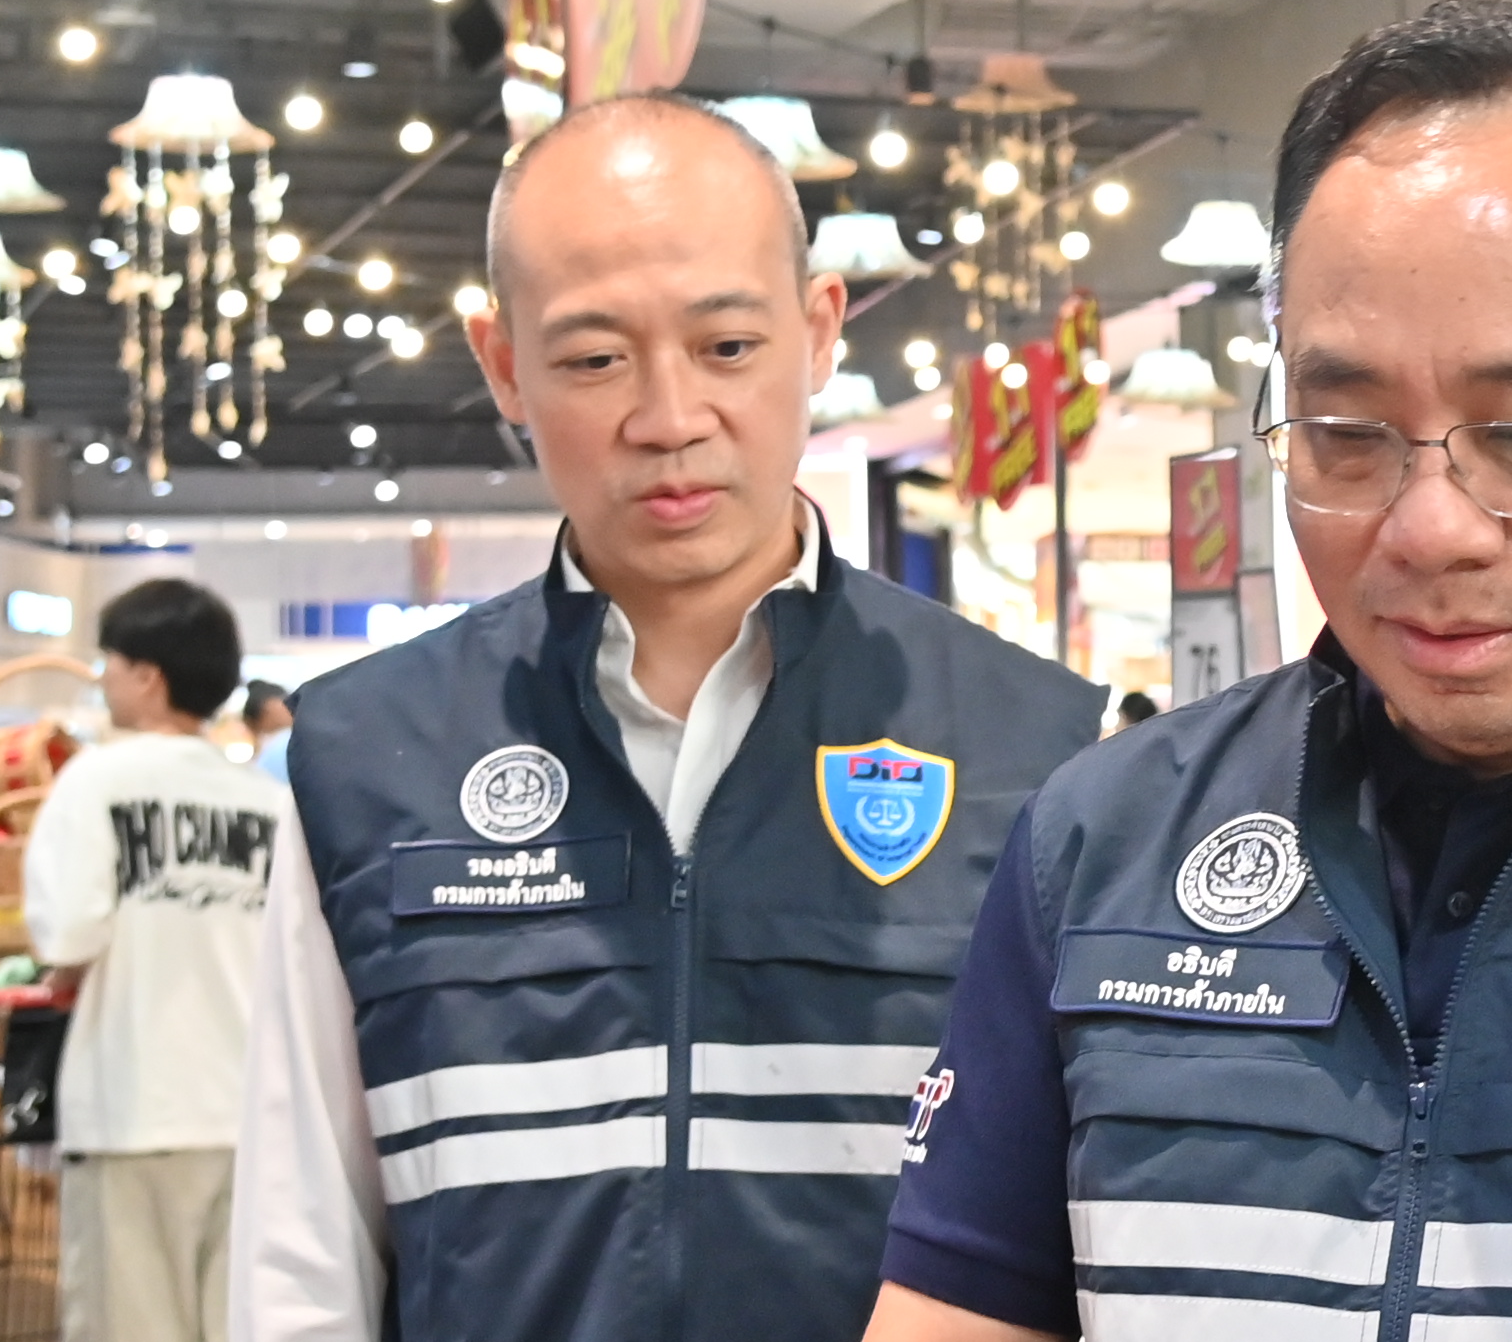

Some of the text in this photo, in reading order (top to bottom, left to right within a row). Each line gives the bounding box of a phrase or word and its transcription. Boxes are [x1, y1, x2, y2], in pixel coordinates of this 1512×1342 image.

[431, 873, 586, 907] กรมการค้าภายใน
[1166, 945, 1238, 978] อธิบดี
[1097, 978, 1287, 1016] กรมการค้าภายใน
